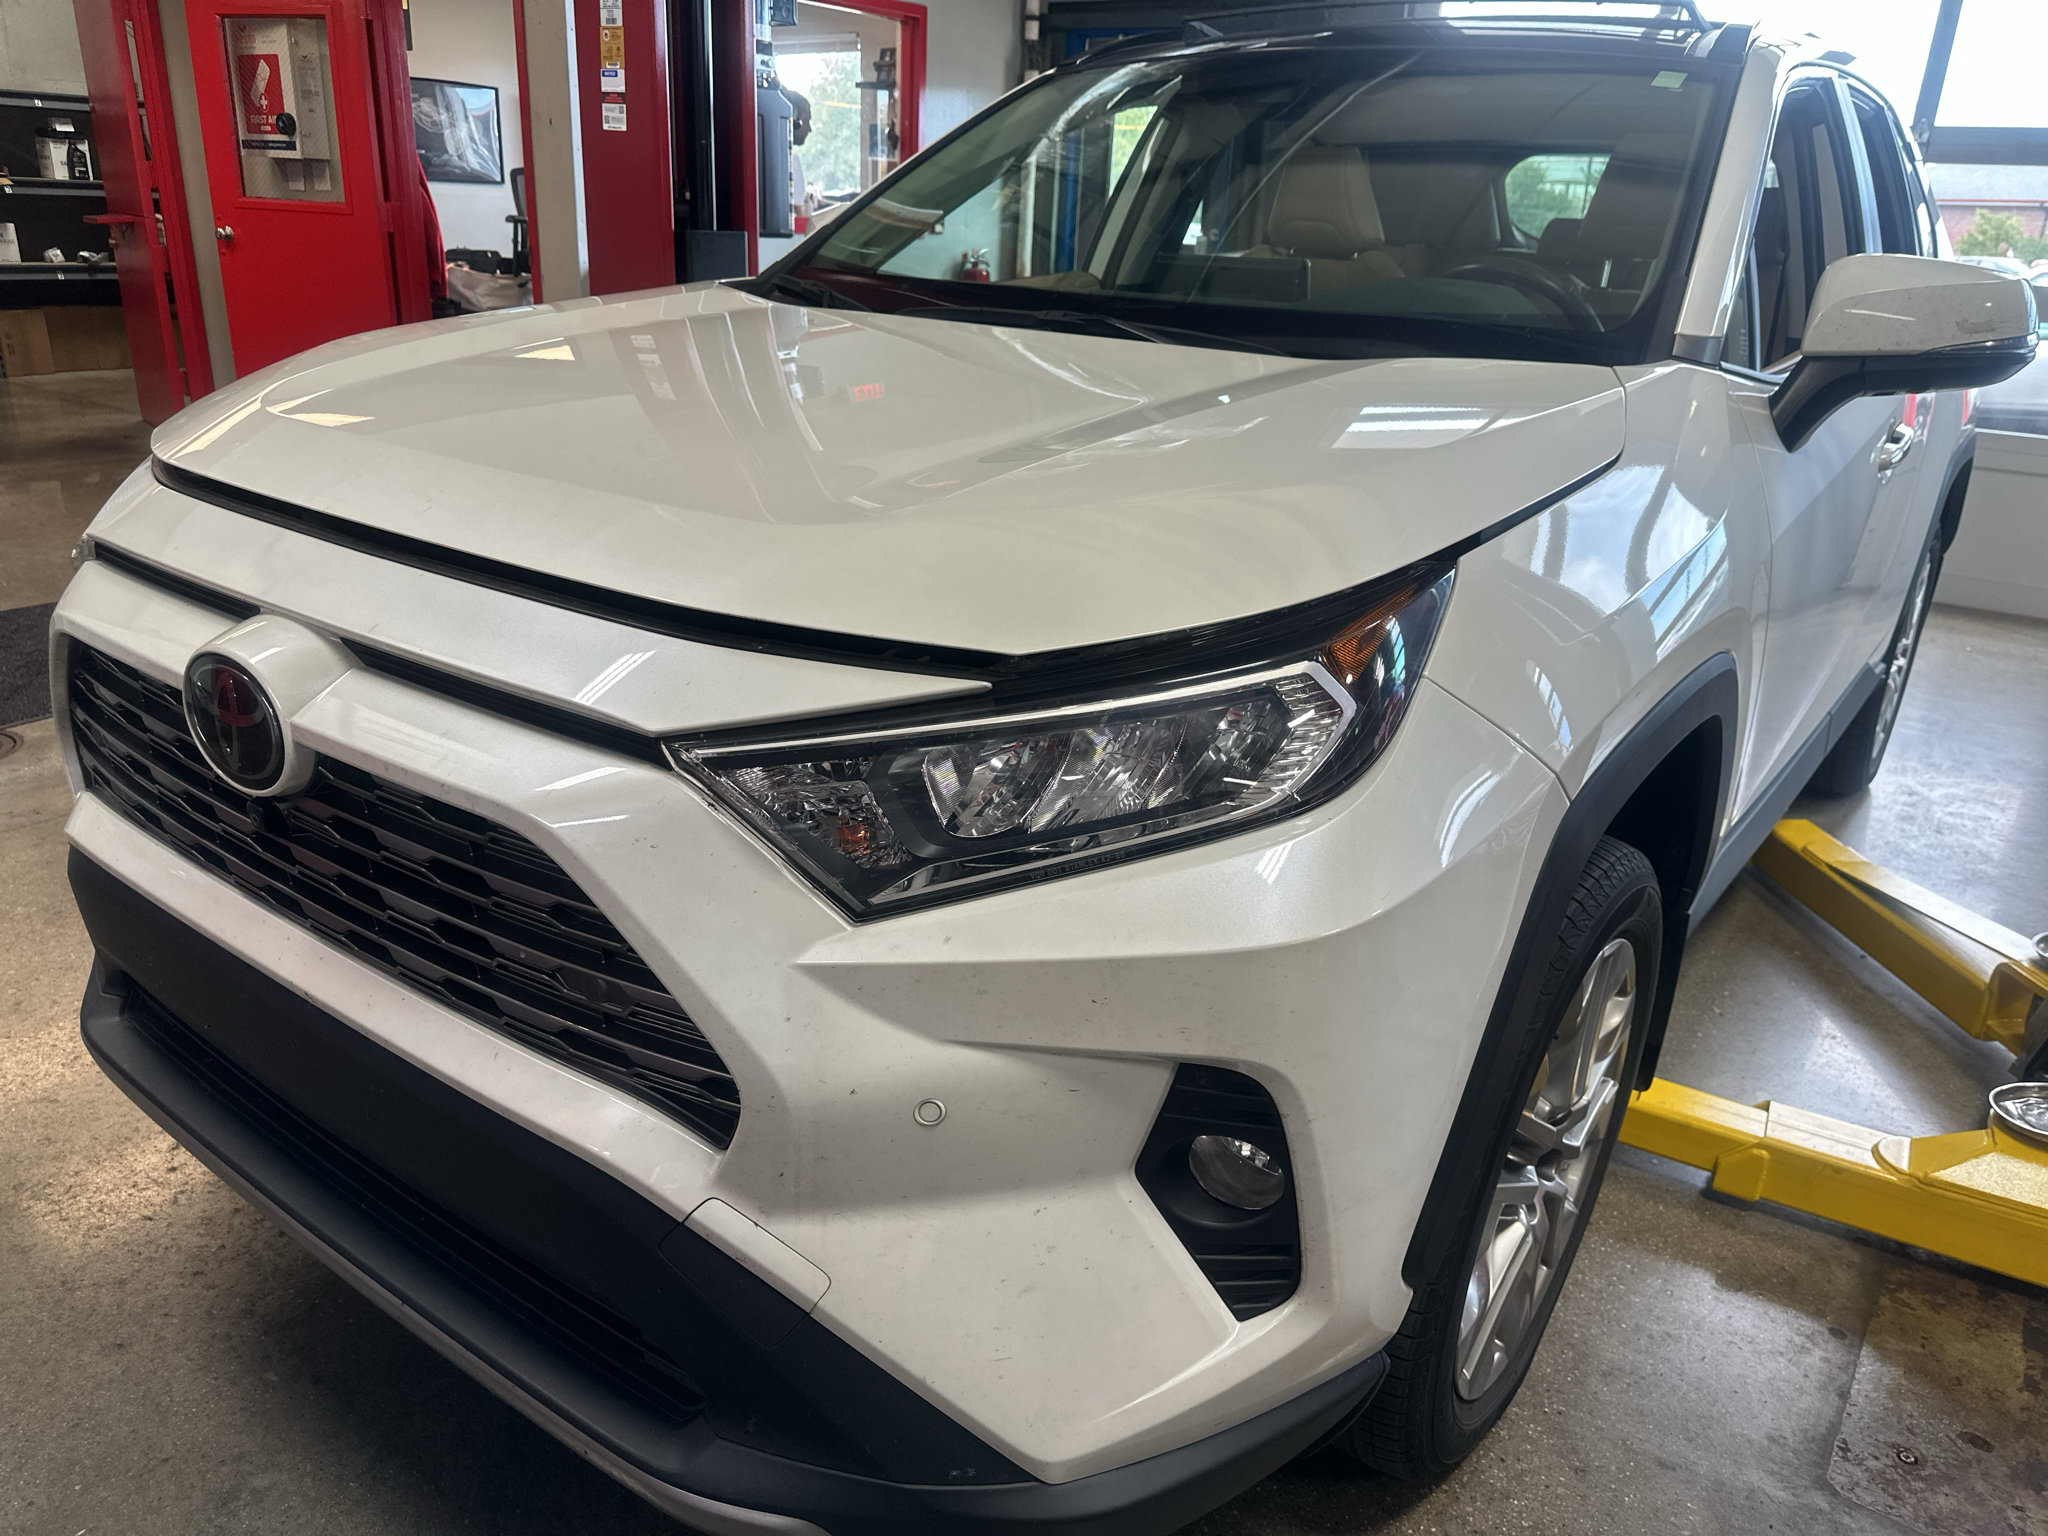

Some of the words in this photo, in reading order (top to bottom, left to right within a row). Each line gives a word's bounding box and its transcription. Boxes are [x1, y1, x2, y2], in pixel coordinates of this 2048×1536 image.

[250, 114, 267, 124] FIRST
[1047, 865, 1063, 876] DOT
[1064, 857, 1098, 871] STANLEY
